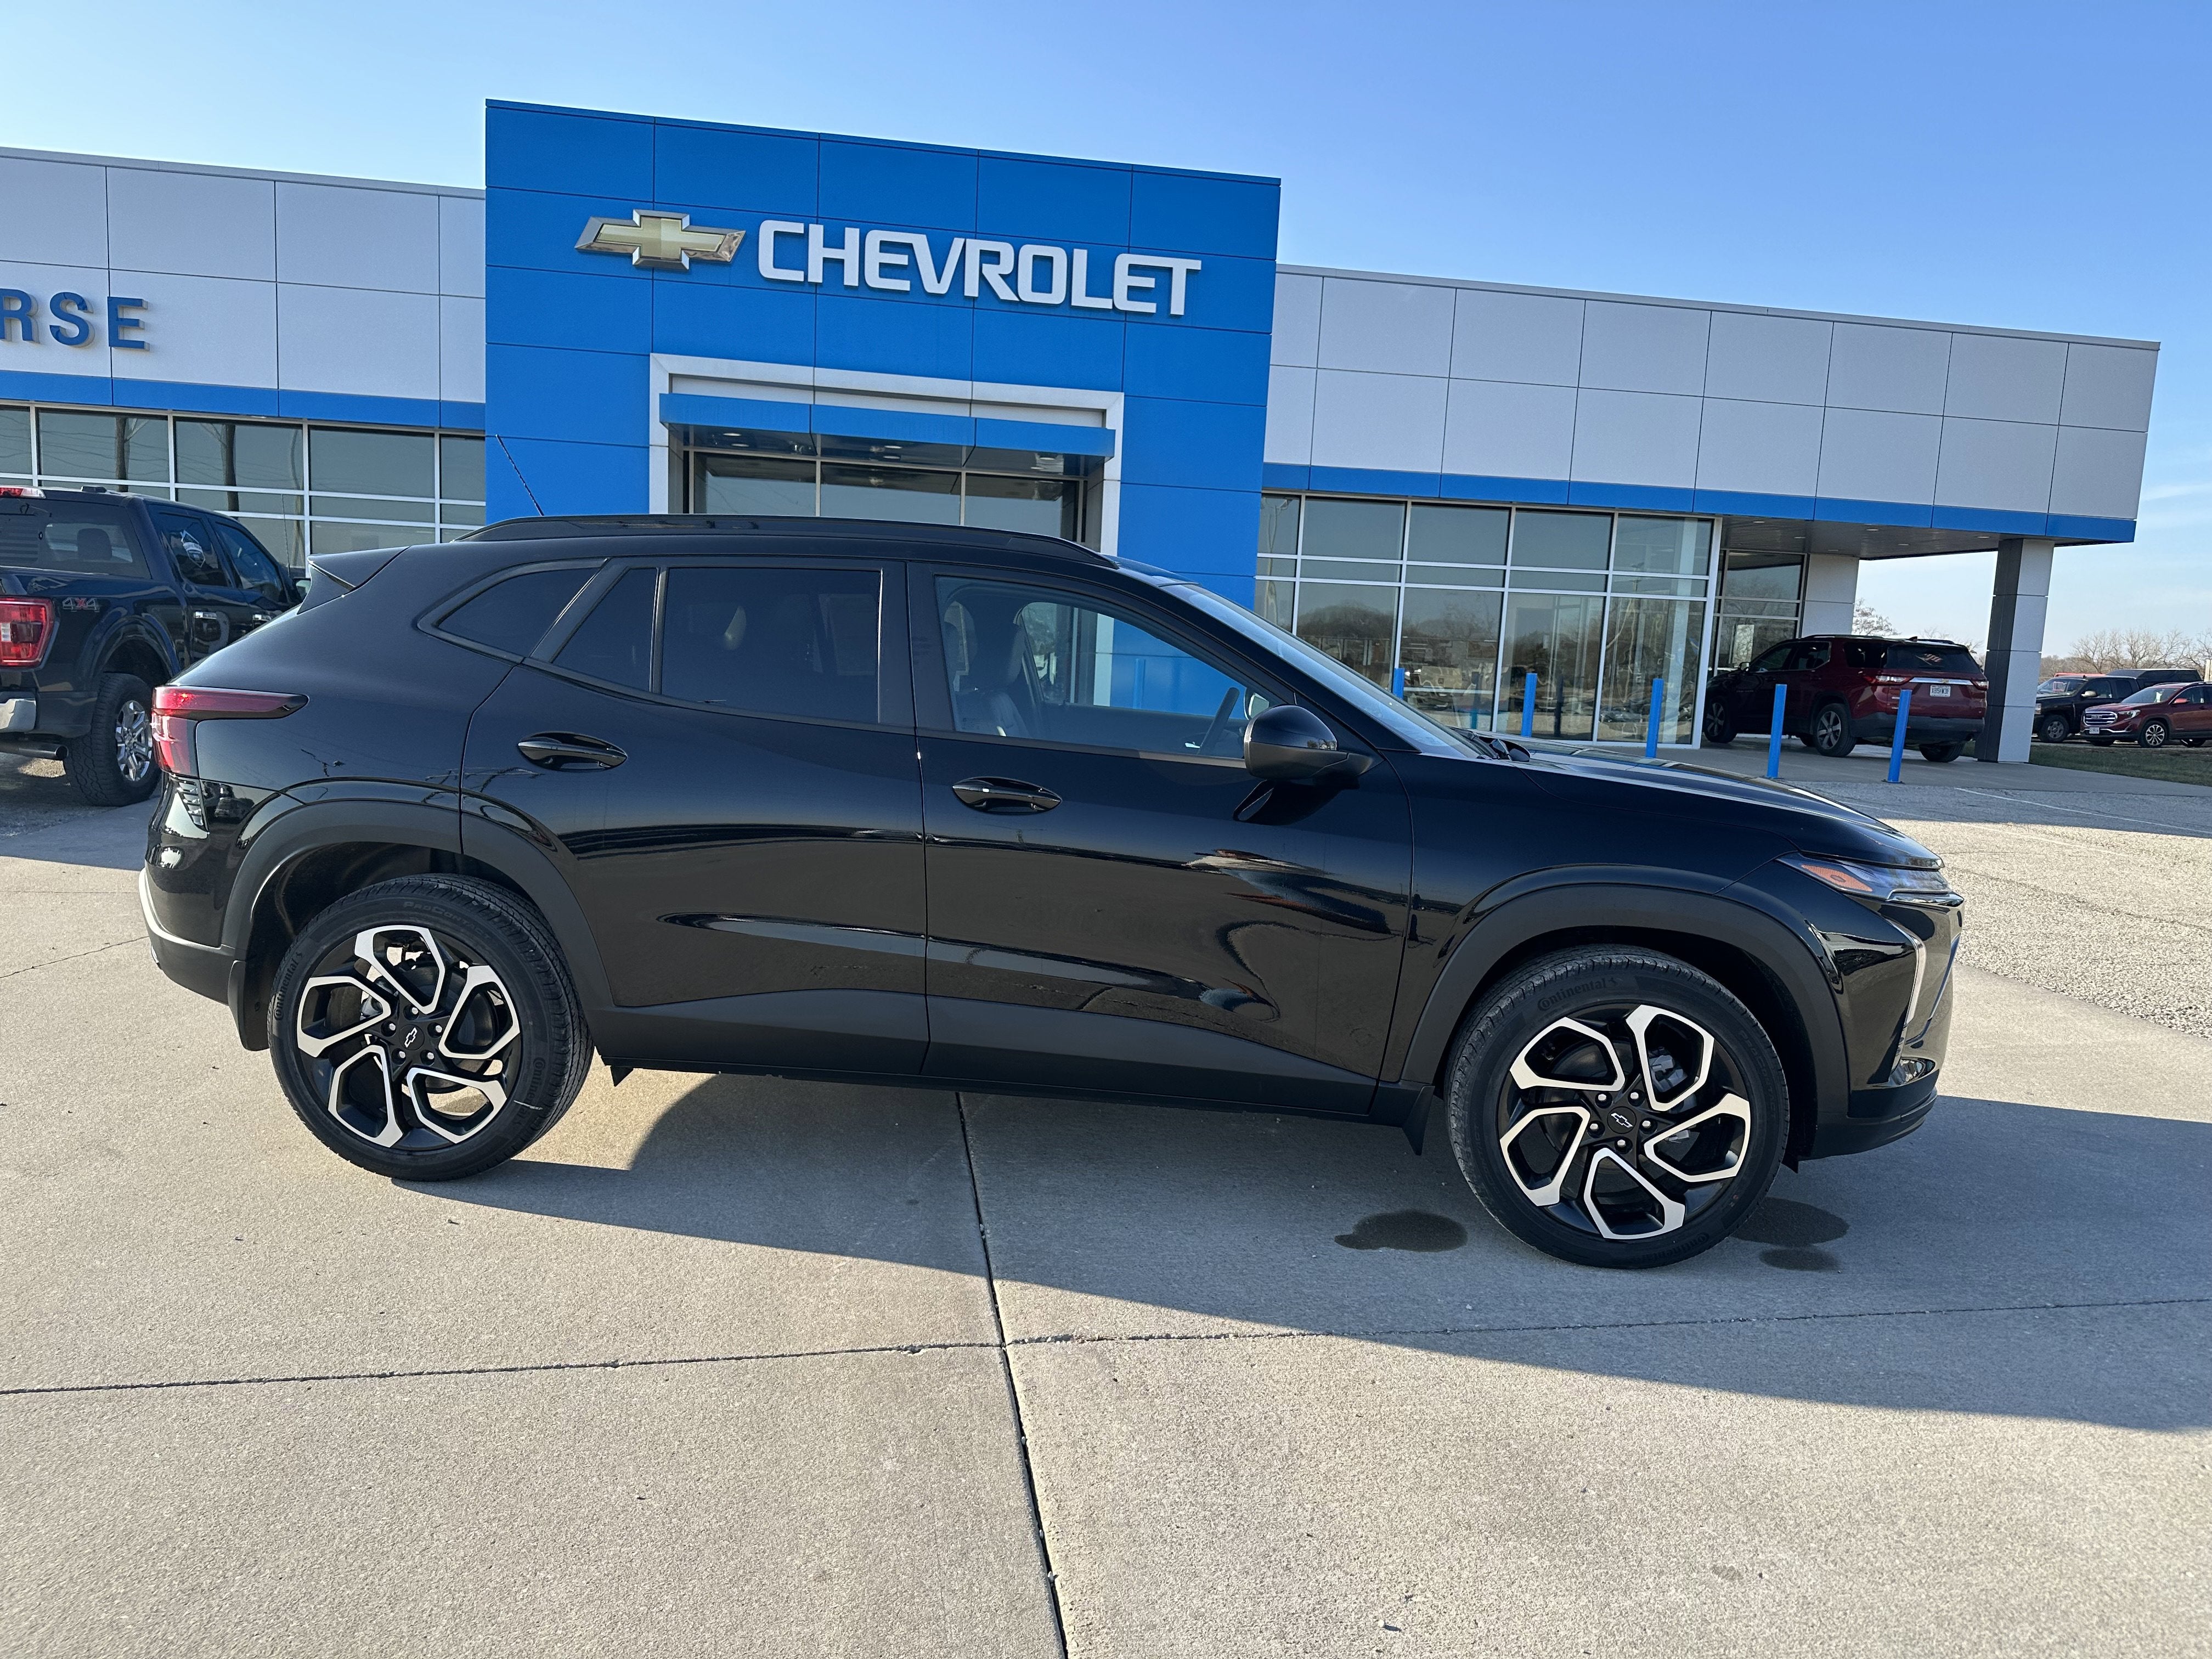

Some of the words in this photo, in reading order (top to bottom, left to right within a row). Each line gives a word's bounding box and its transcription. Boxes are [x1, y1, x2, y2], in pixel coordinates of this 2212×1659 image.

[758, 219, 1202, 315] CHEVROLET
[0, 288, 148, 349] RSE
[274, 957, 299, 1021] Continental
[1537, 978, 1608, 1012] Continental
[515, 1056, 546, 1119] Continenal
